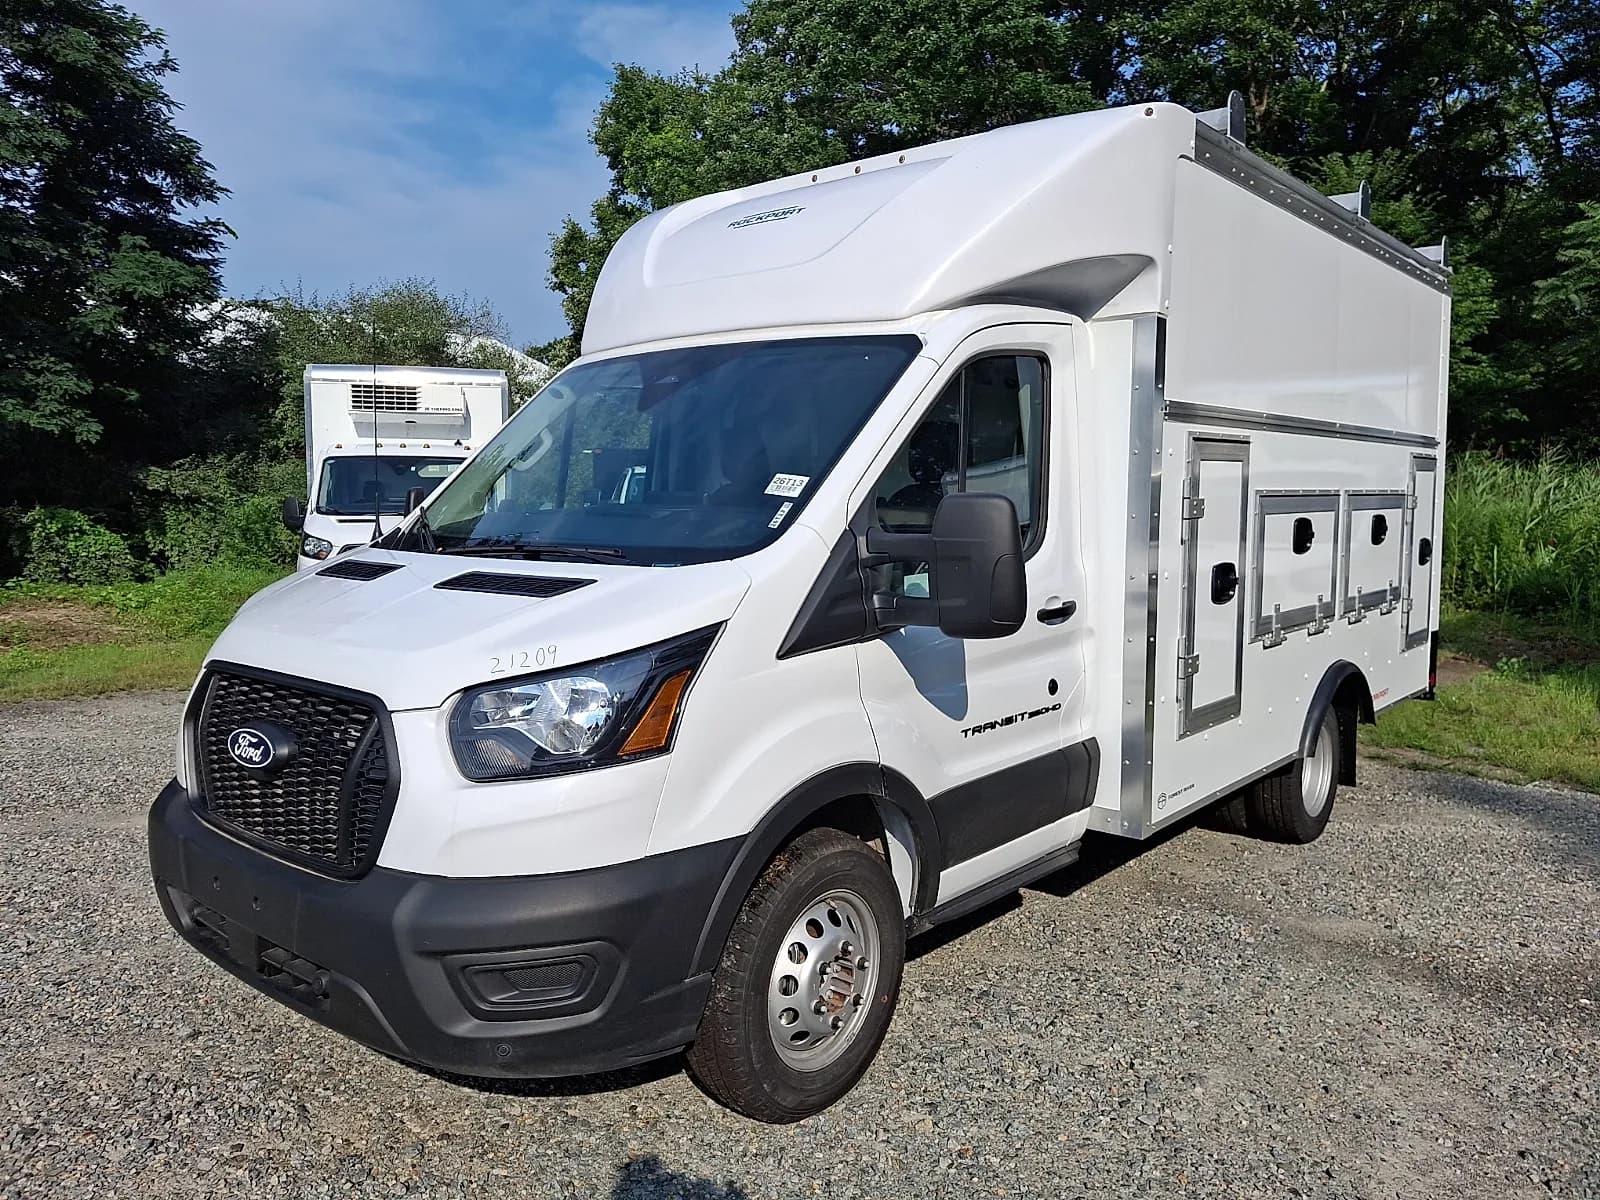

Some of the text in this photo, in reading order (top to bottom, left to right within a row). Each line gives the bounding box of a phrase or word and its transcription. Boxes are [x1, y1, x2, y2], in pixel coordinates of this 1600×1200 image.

[727, 207, 806, 228] ROCKPORT
[773, 477, 804, 487] 26T13
[489, 644, 557, 673] 21209
[961, 711, 1027, 738] TRANSIT
[234, 733, 265, 762] Ford
